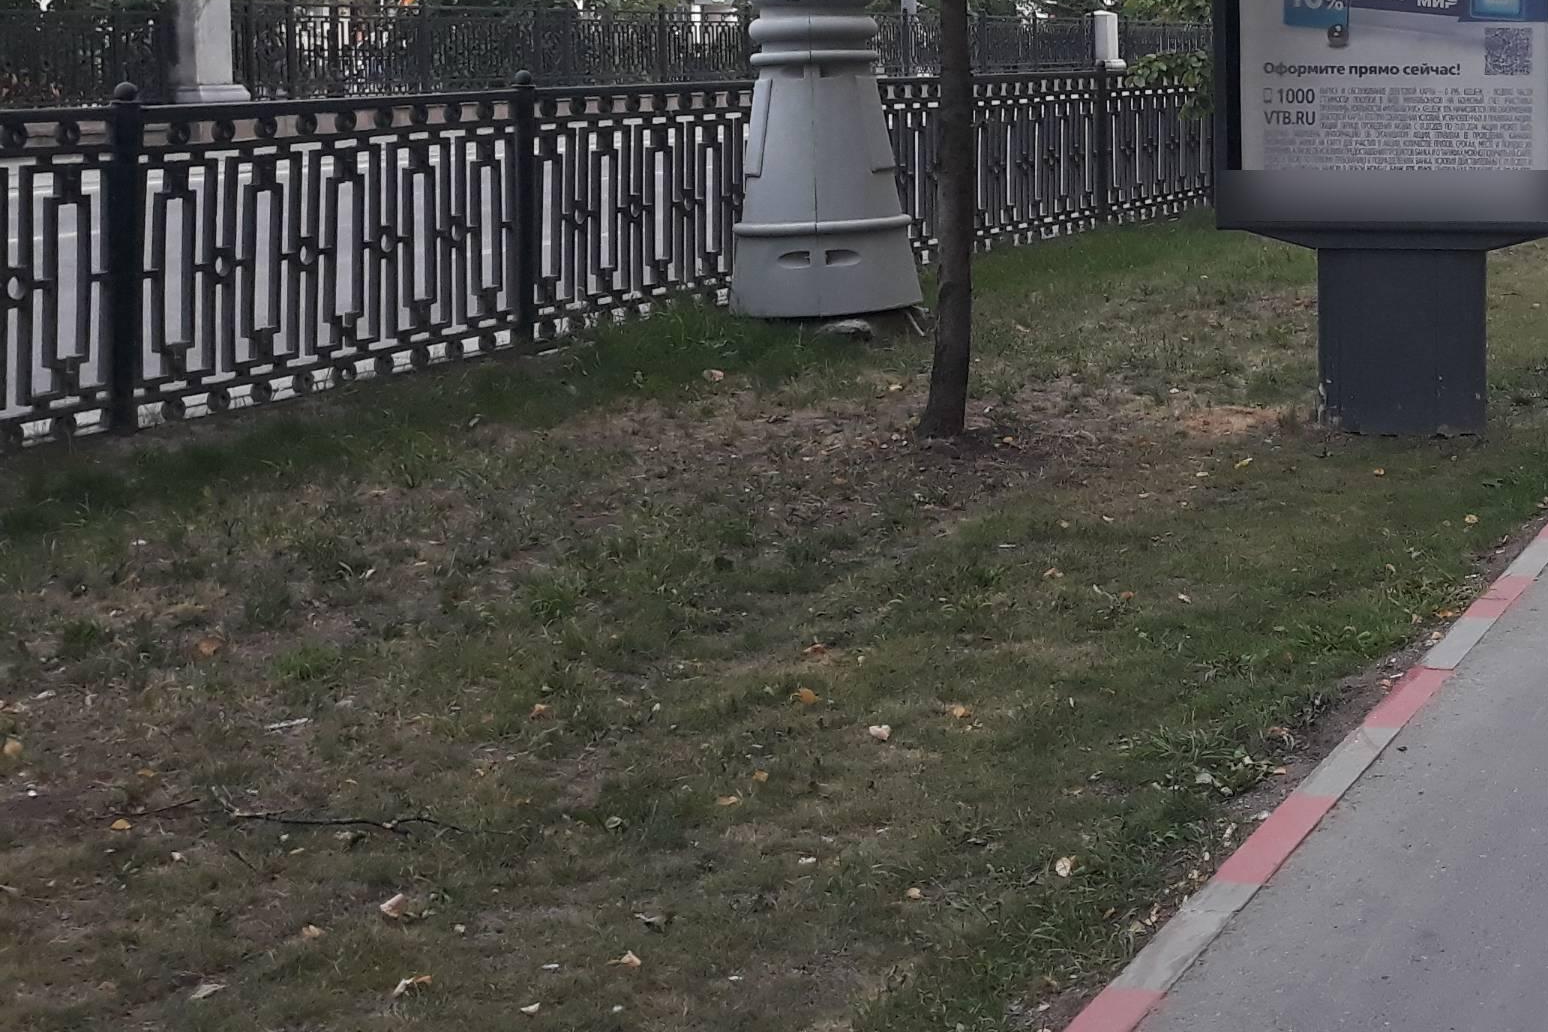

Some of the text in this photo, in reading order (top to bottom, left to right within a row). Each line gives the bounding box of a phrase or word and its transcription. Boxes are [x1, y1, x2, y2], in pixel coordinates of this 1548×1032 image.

[1263, 62, 1460, 77] Оформите прямо сейчас!
[1278, 88, 1315, 104] 1000
[1264, 111, 1315, 125] VTB.RU
